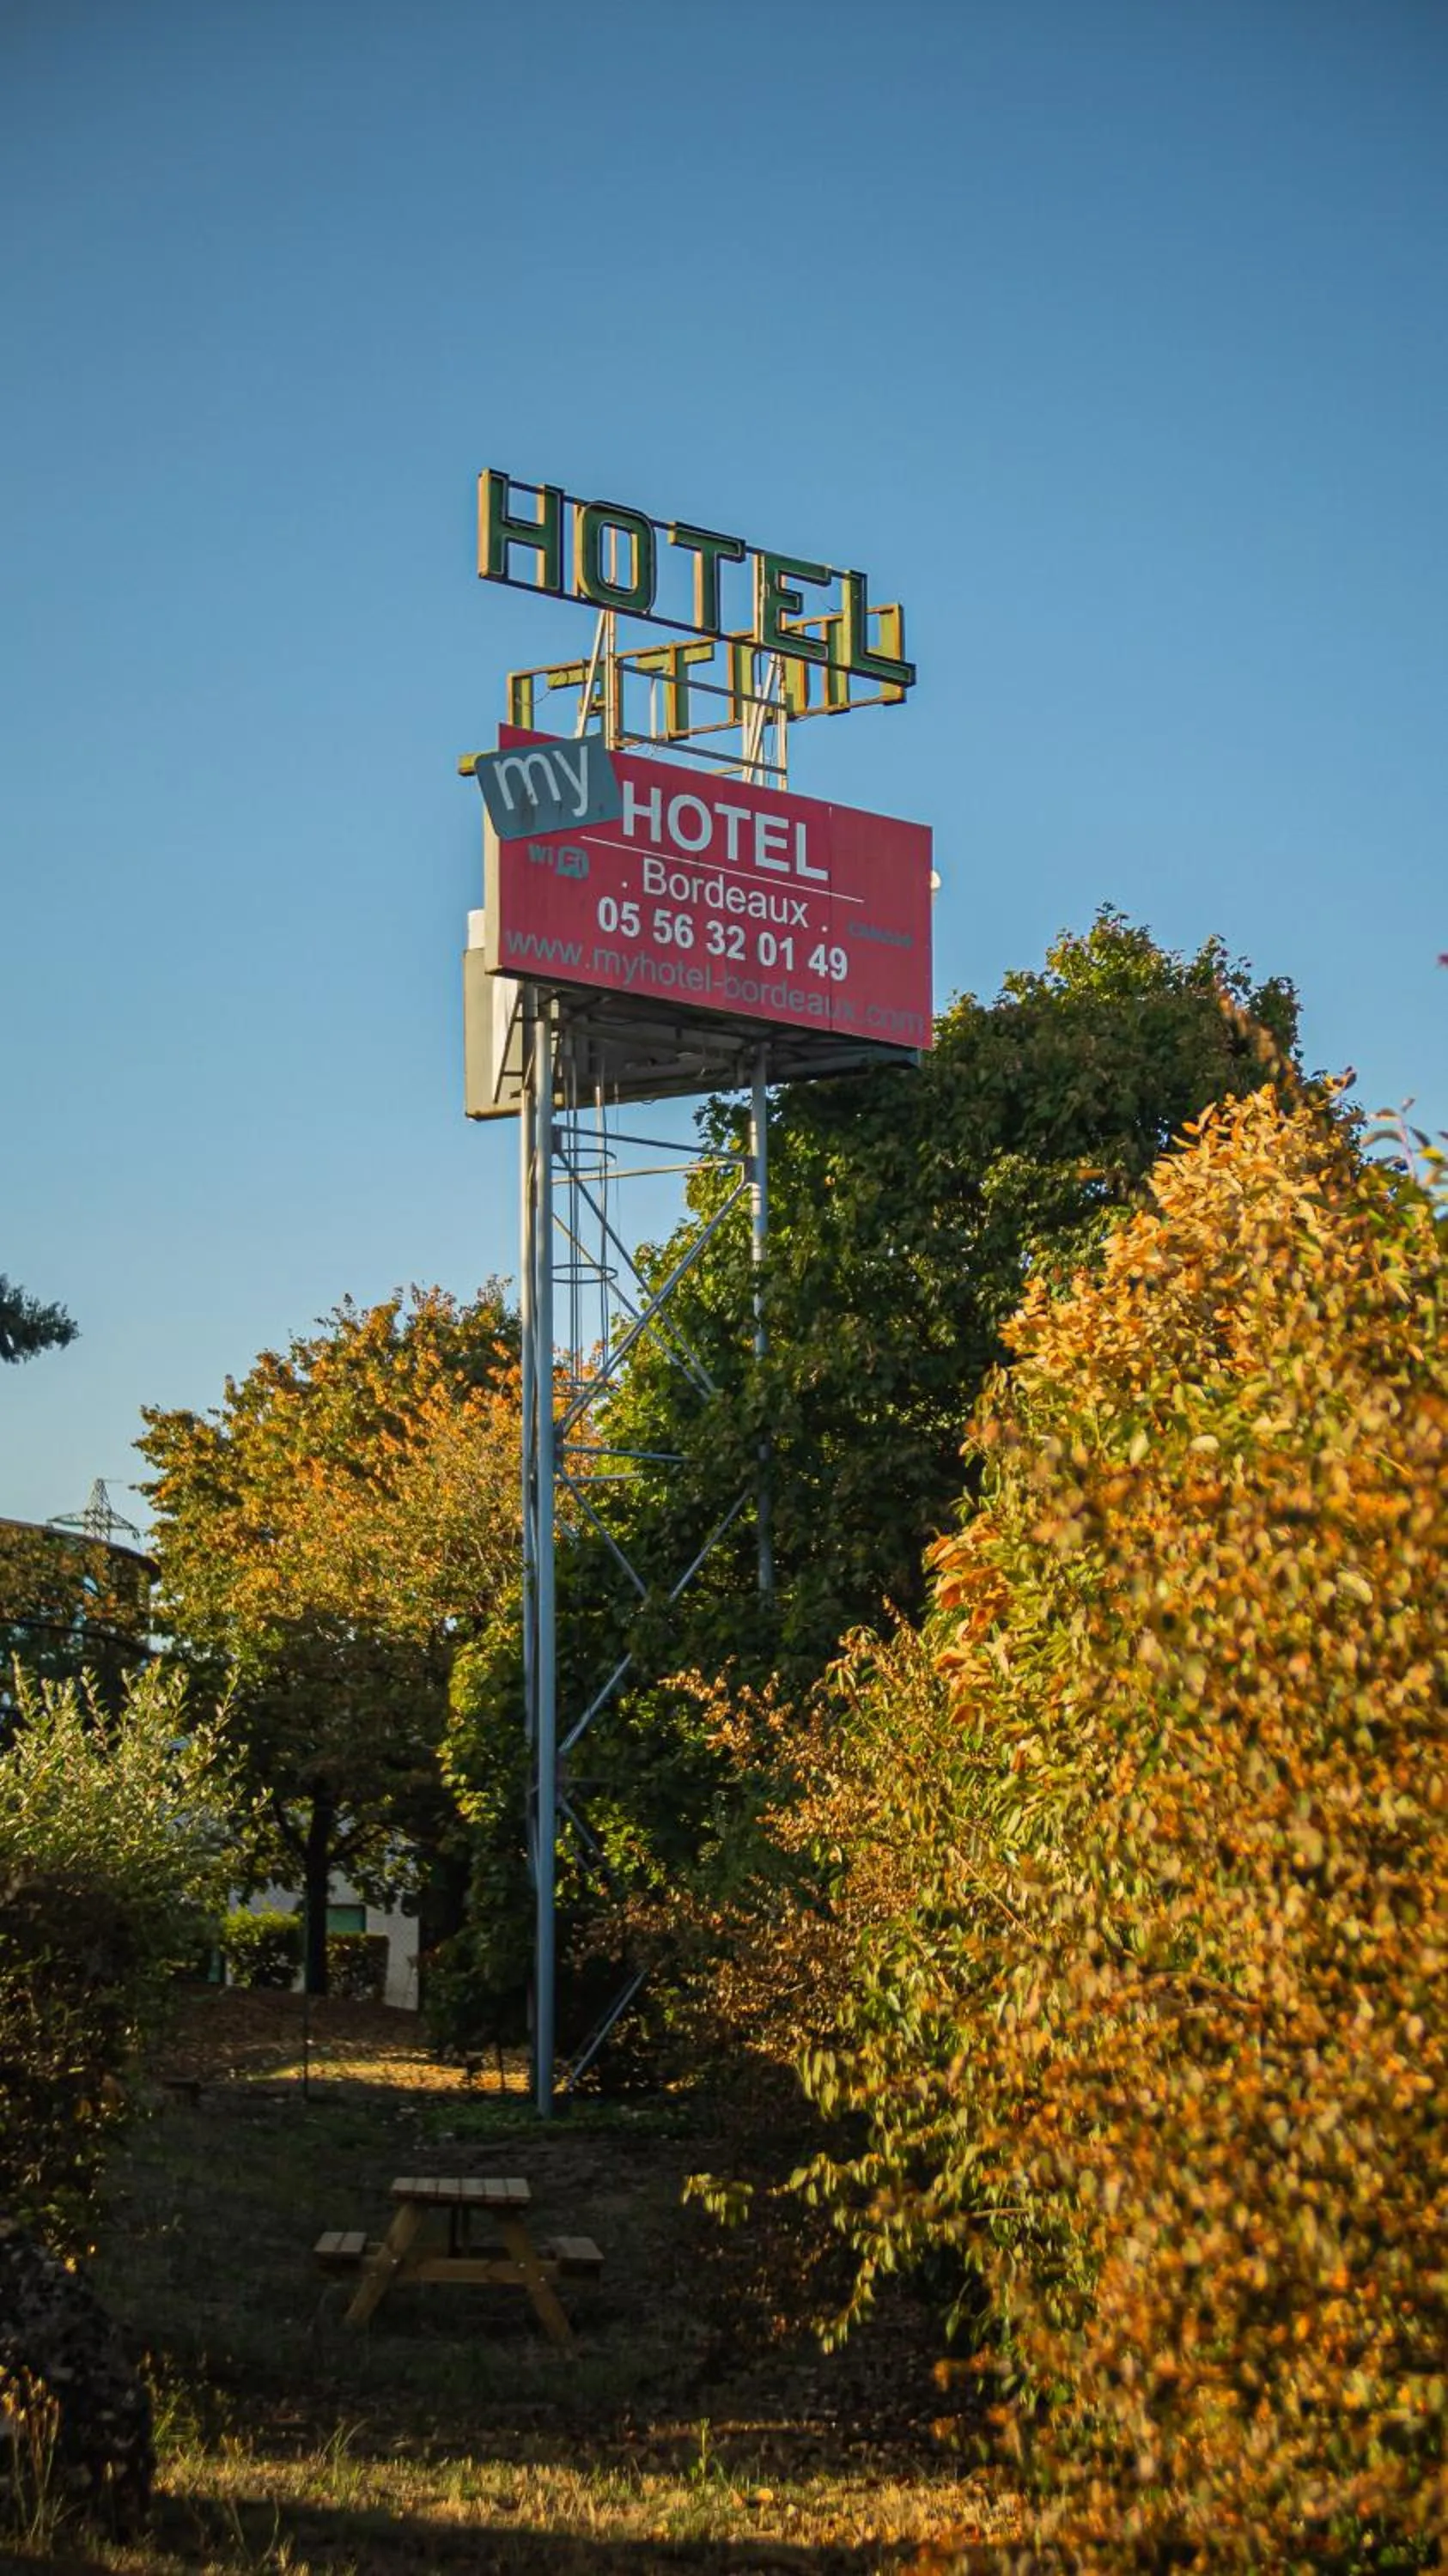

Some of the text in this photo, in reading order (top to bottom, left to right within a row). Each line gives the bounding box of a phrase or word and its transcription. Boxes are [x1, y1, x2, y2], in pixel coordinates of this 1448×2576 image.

[478, 468, 916, 687] HOTEL
[493, 744, 828, 881] my HOTEL
[597, 896, 848, 981] 05 56 32 01 49
[642, 858, 810, 928] Bordeaux
